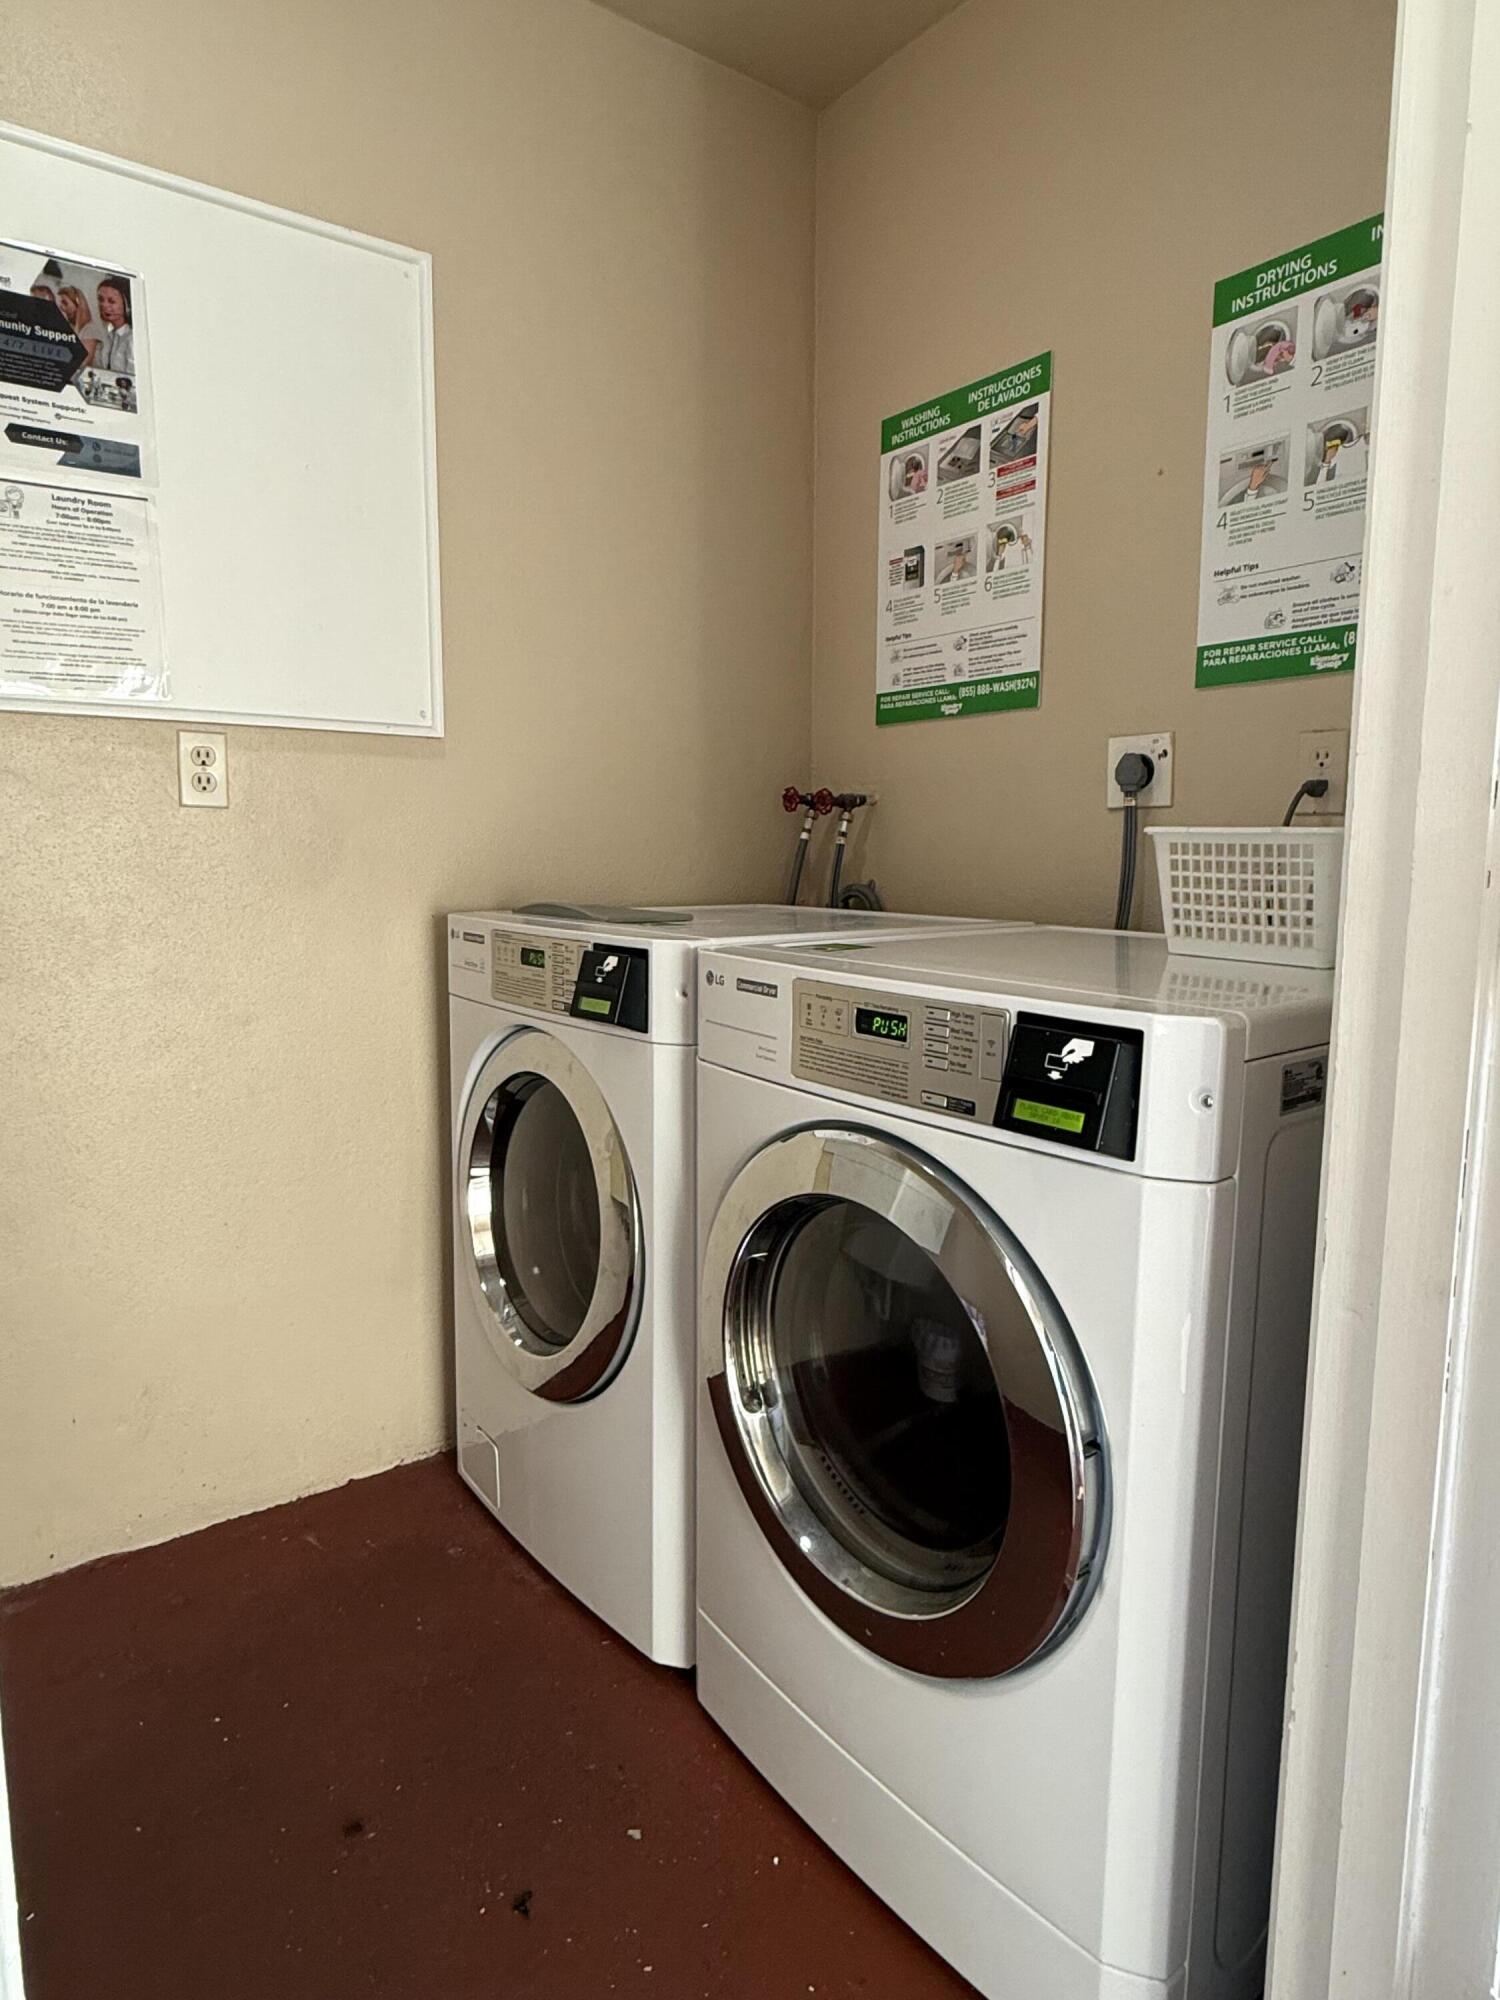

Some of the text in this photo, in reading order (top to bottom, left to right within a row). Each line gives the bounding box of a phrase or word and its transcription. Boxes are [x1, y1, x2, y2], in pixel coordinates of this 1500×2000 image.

[1256, 254, 1312, 289] DRYING
[1231, 259, 1338, 313] INSTRUCTIONS
[34, 325, 76, 343] Support
[967, 364, 1042, 404] INSTRUCCIONES
[1311, 366, 1323, 387] 2
[977, 382, 1031, 413] DE LAVADO
[1223, 394, 1230, 413] 1
[901, 406, 940, 430] WASHING
[22, 430, 54, 443] Contact
[891, 413, 951, 446] INSTRUCTIONS
[988, 472, 996, 488] 3
[51, 493, 112, 508] Laundry Room
[936, 489, 943, 505] 2
[1303, 491, 1315, 511] 5
[51, 503, 71, 512] Hours
[80, 508, 113, 517] Operation
[889, 505, 893, 519] 1
[1216, 512, 1228, 531] 4
[1214, 561, 1259, 578] Helpful Tips
[984, 576, 992, 592] 6
[934, 588, 941, 604] 5
[885, 600, 892, 614] 4
[1203, 634, 1327, 659] FOR REPAIR SERVICE CALL:
[1203, 656, 1226, 668] PARA
[1227, 648, 1303, 665] REPARACIONES
[912, 691, 934, 700] SERVICE
[958, 685, 976, 699] (855)
[714, 973, 725, 986] LG
[872, 1017, 907, 1037] PUSH
